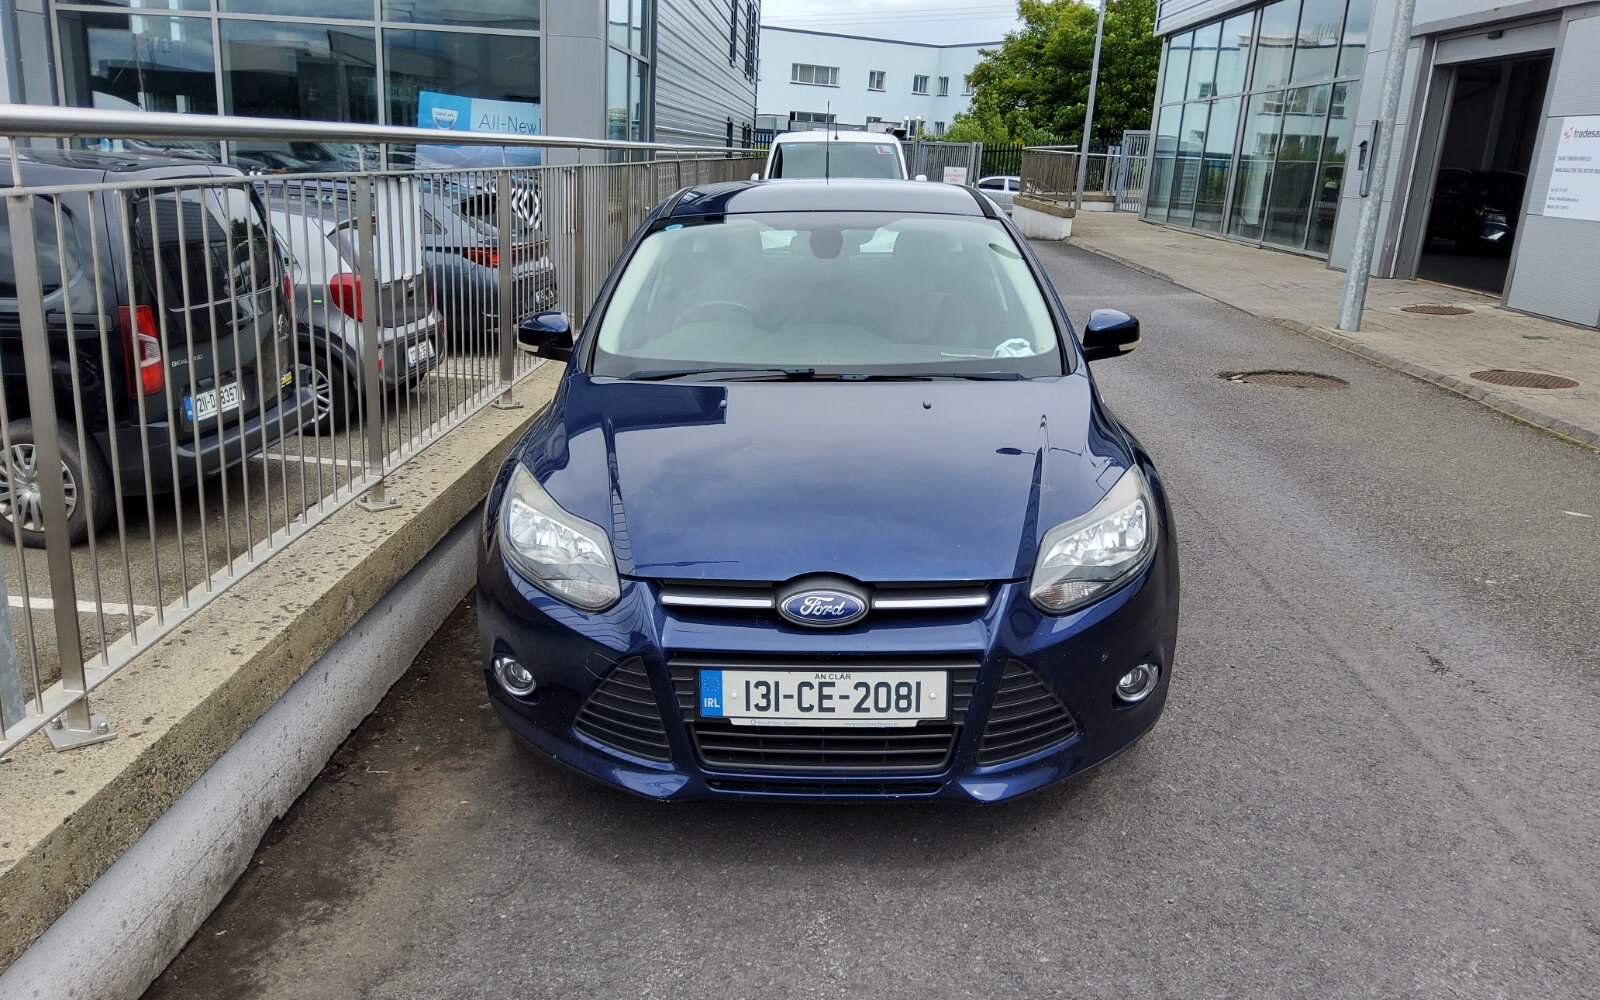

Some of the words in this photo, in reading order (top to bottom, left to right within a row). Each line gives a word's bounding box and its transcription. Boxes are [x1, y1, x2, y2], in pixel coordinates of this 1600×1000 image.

[479, 113, 537, 134] All-New
[171, 354, 203, 367] BERLGO
[800, 597, 845, 616] Ford
[704, 697, 720, 708] IRL
[745, 680, 922, 713] 131-CE-2081
